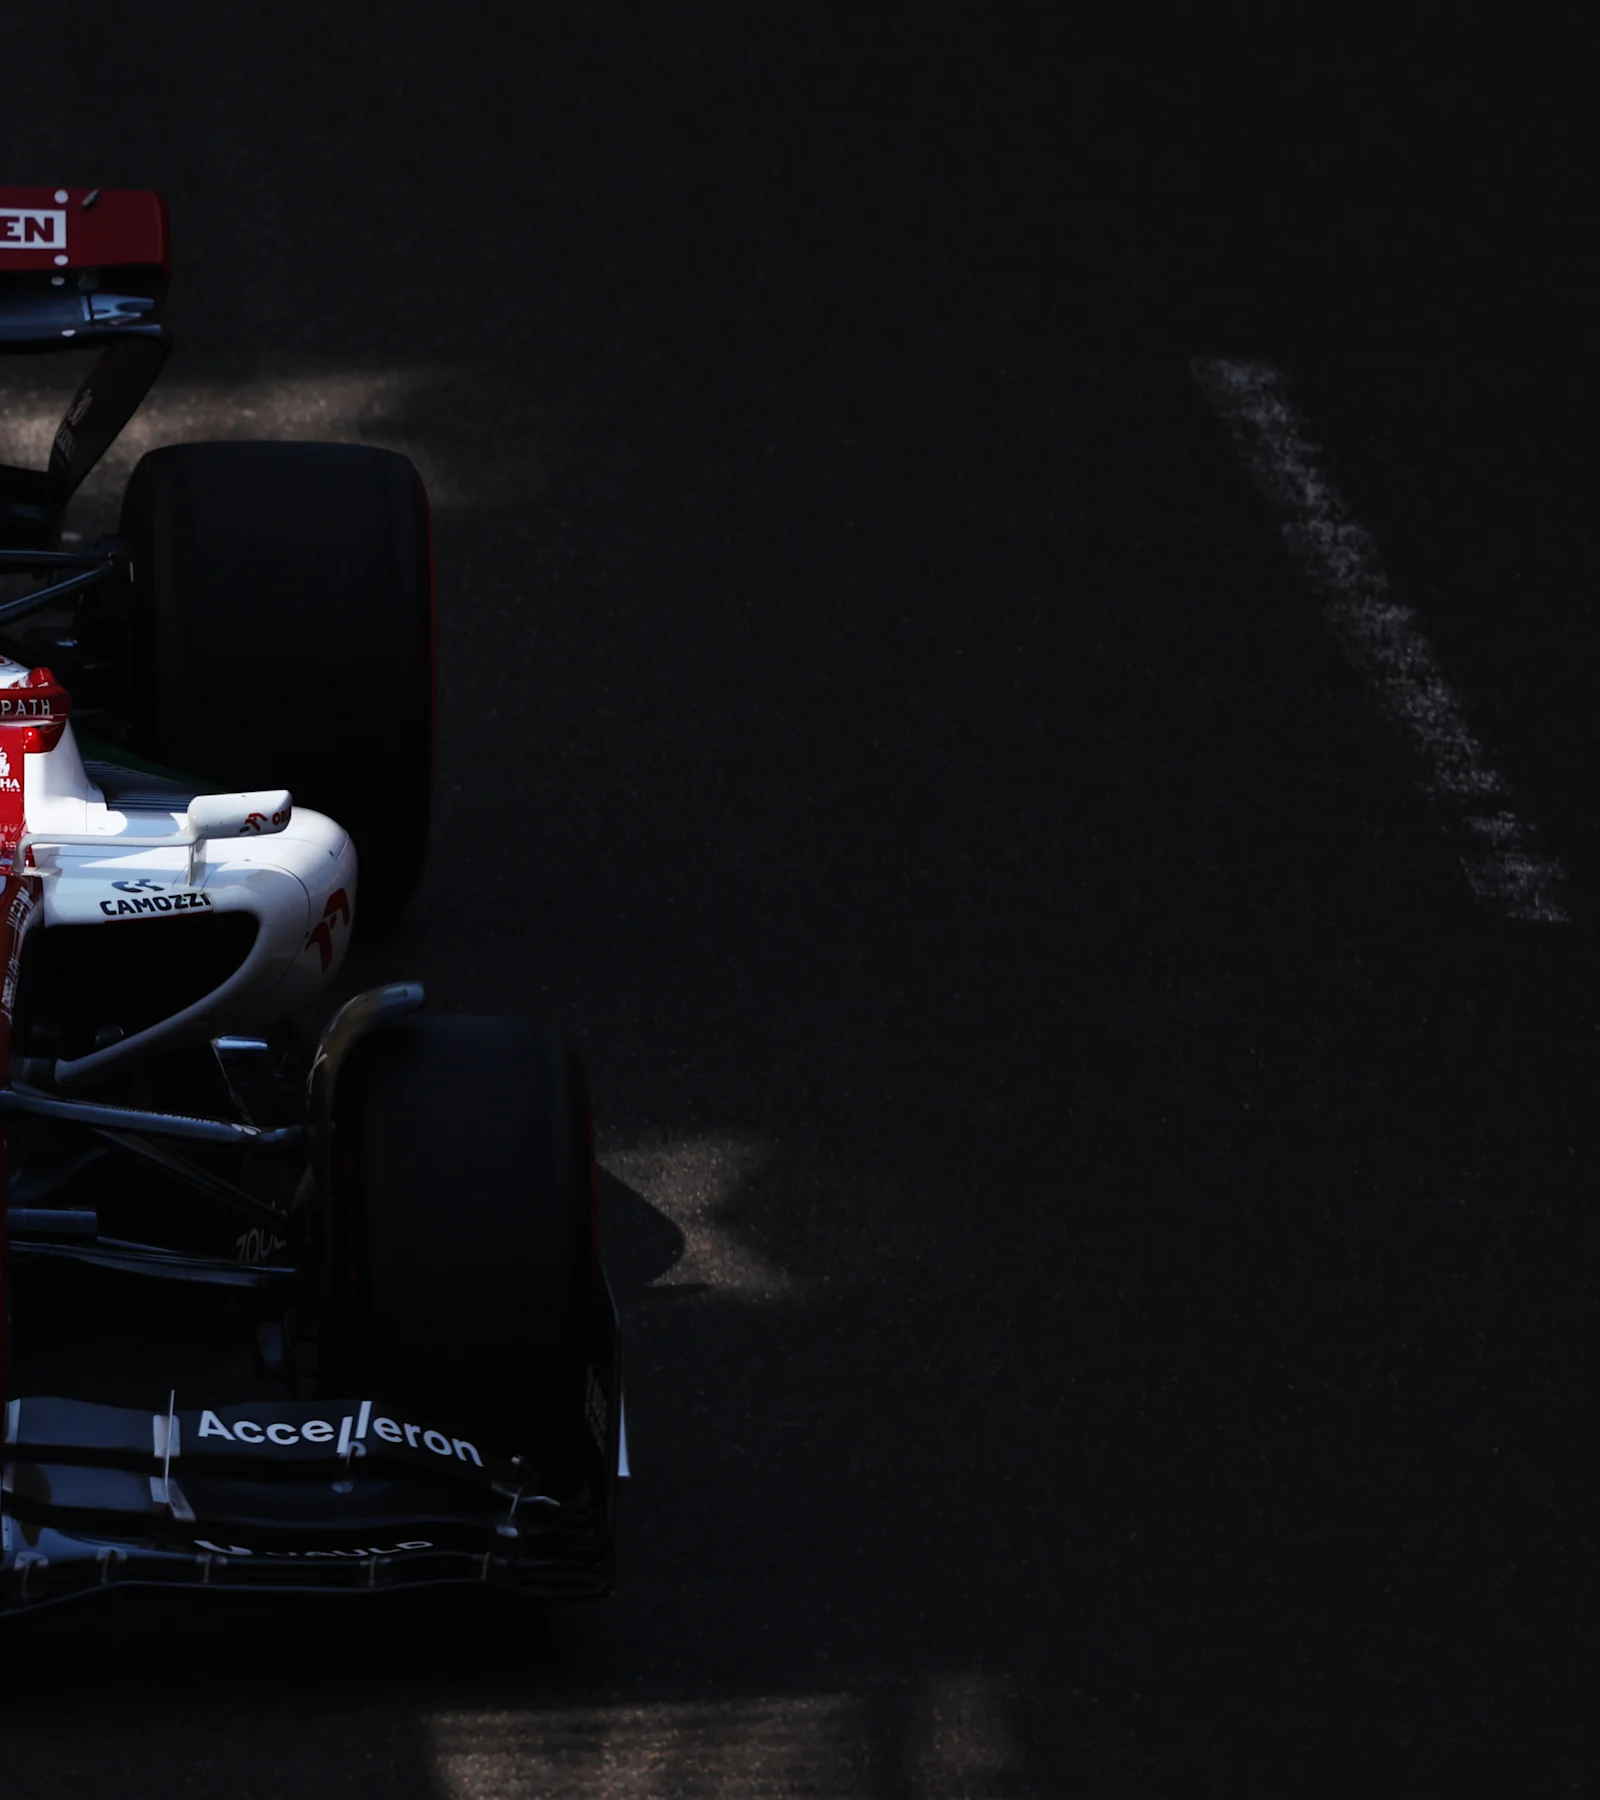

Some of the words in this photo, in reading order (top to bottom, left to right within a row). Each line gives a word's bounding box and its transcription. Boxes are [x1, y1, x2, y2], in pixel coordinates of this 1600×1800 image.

[1, 699, 51, 716] PATH
[99, 892, 213, 916] CAMOZZI
[197, 1400, 485, 1468] Accelleron
